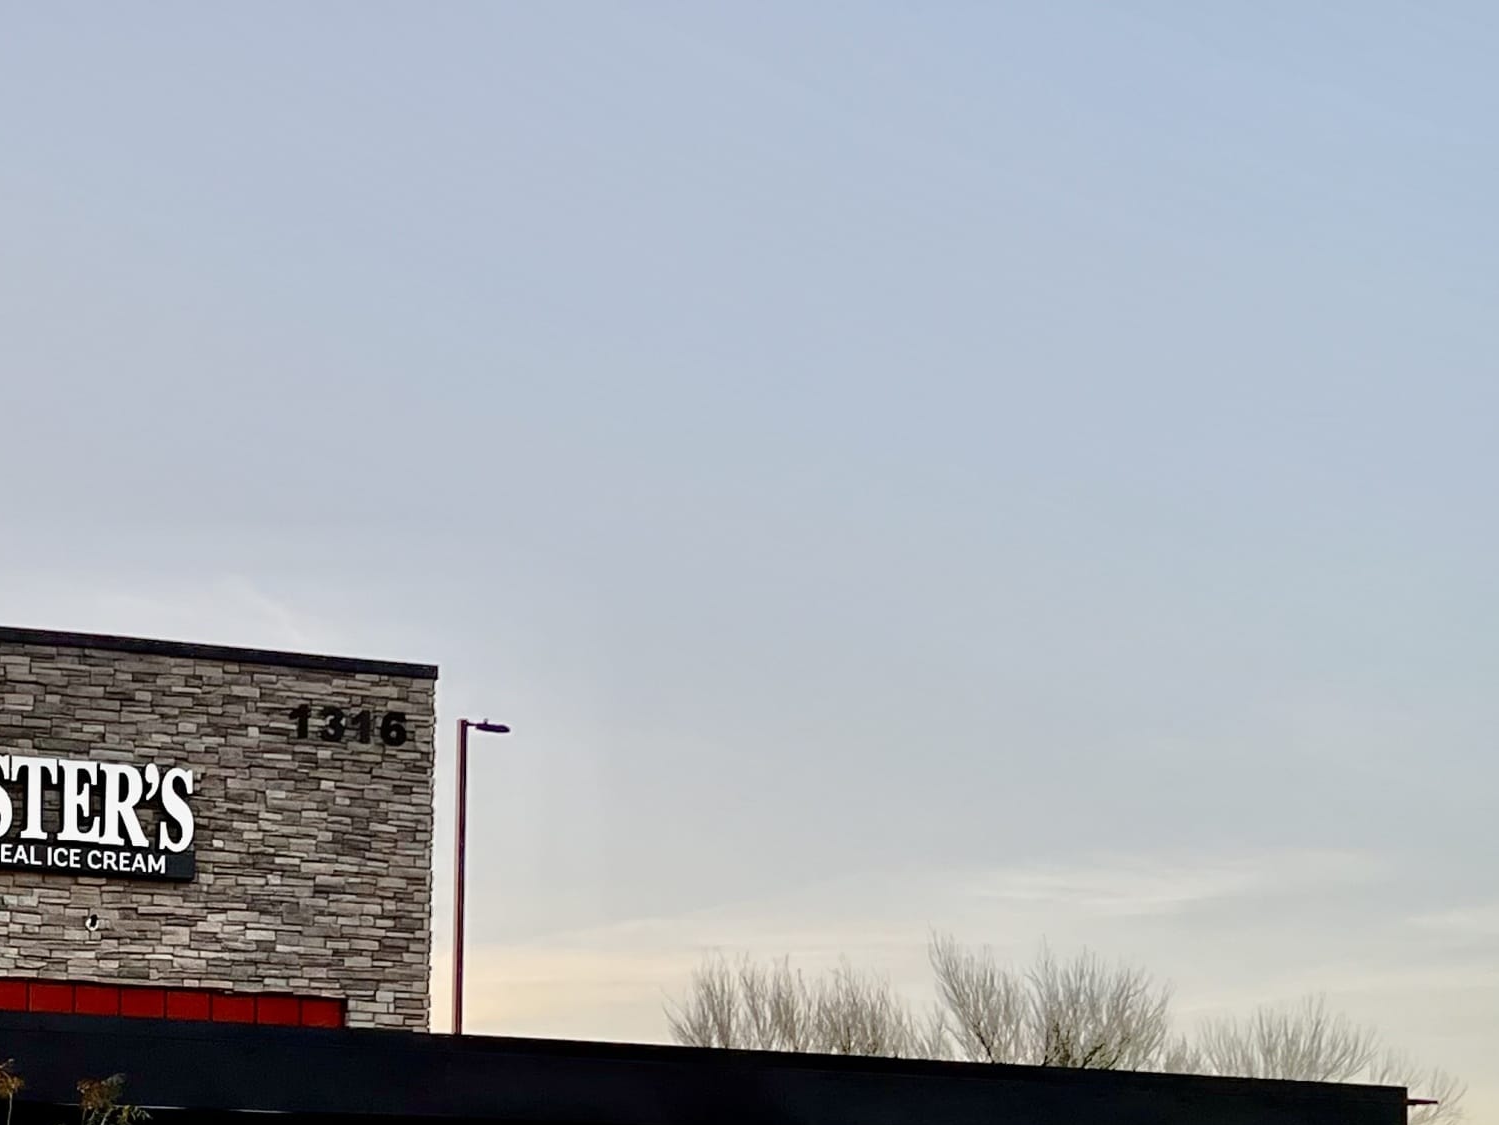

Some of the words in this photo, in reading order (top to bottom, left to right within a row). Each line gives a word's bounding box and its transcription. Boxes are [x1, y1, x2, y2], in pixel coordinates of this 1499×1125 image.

[289, 703, 407, 747] 1316
[46, 846, 82, 869] ICE
[86, 849, 167, 875] CREAM
